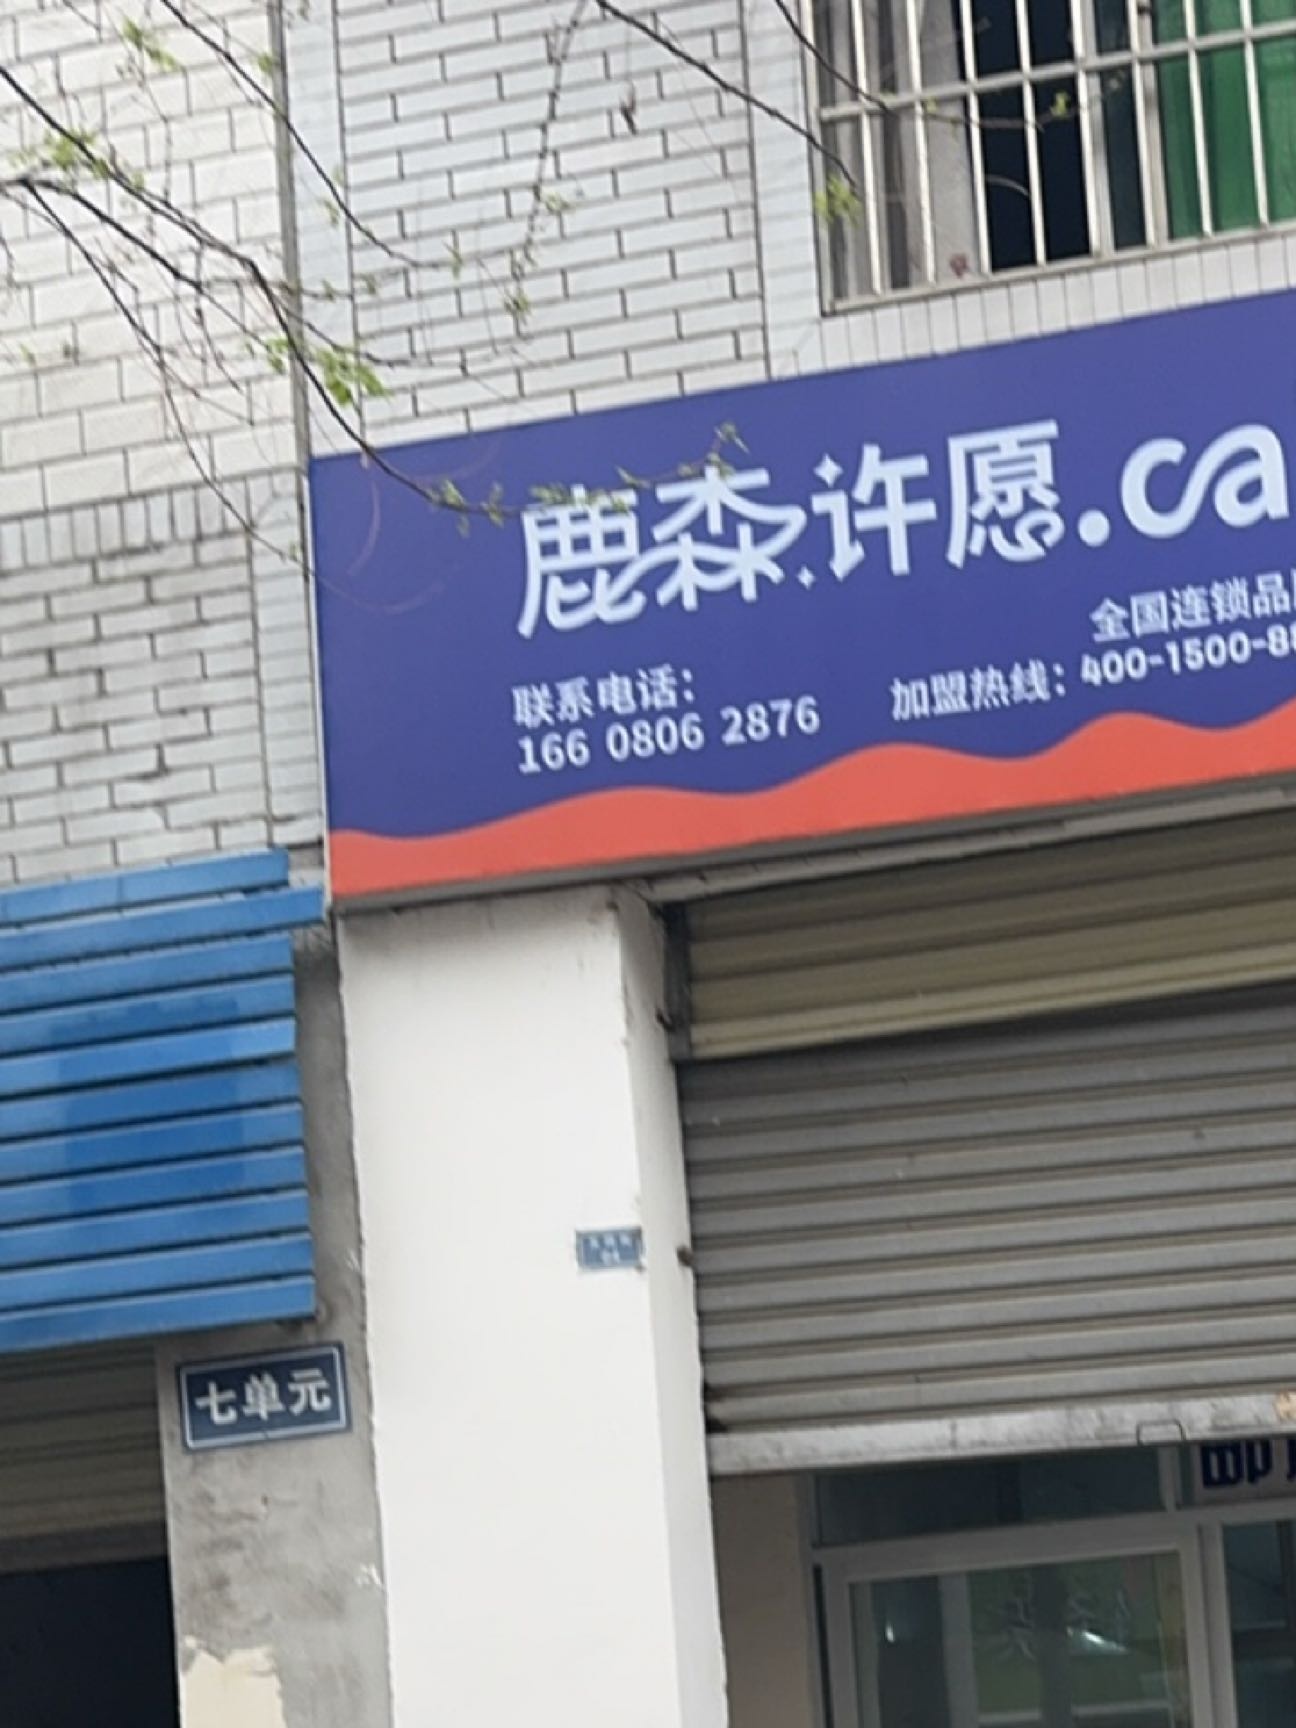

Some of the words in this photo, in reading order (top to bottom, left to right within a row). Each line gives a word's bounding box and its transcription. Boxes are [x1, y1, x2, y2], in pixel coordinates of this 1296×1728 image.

[512, 663, 695, 729] 联系电话：
[518, 728, 591, 774] 166
[605, 712, 706, 762] 0806
[719, 694, 821, 746] 2876
[194, 1367, 332, 1426] 七单元
